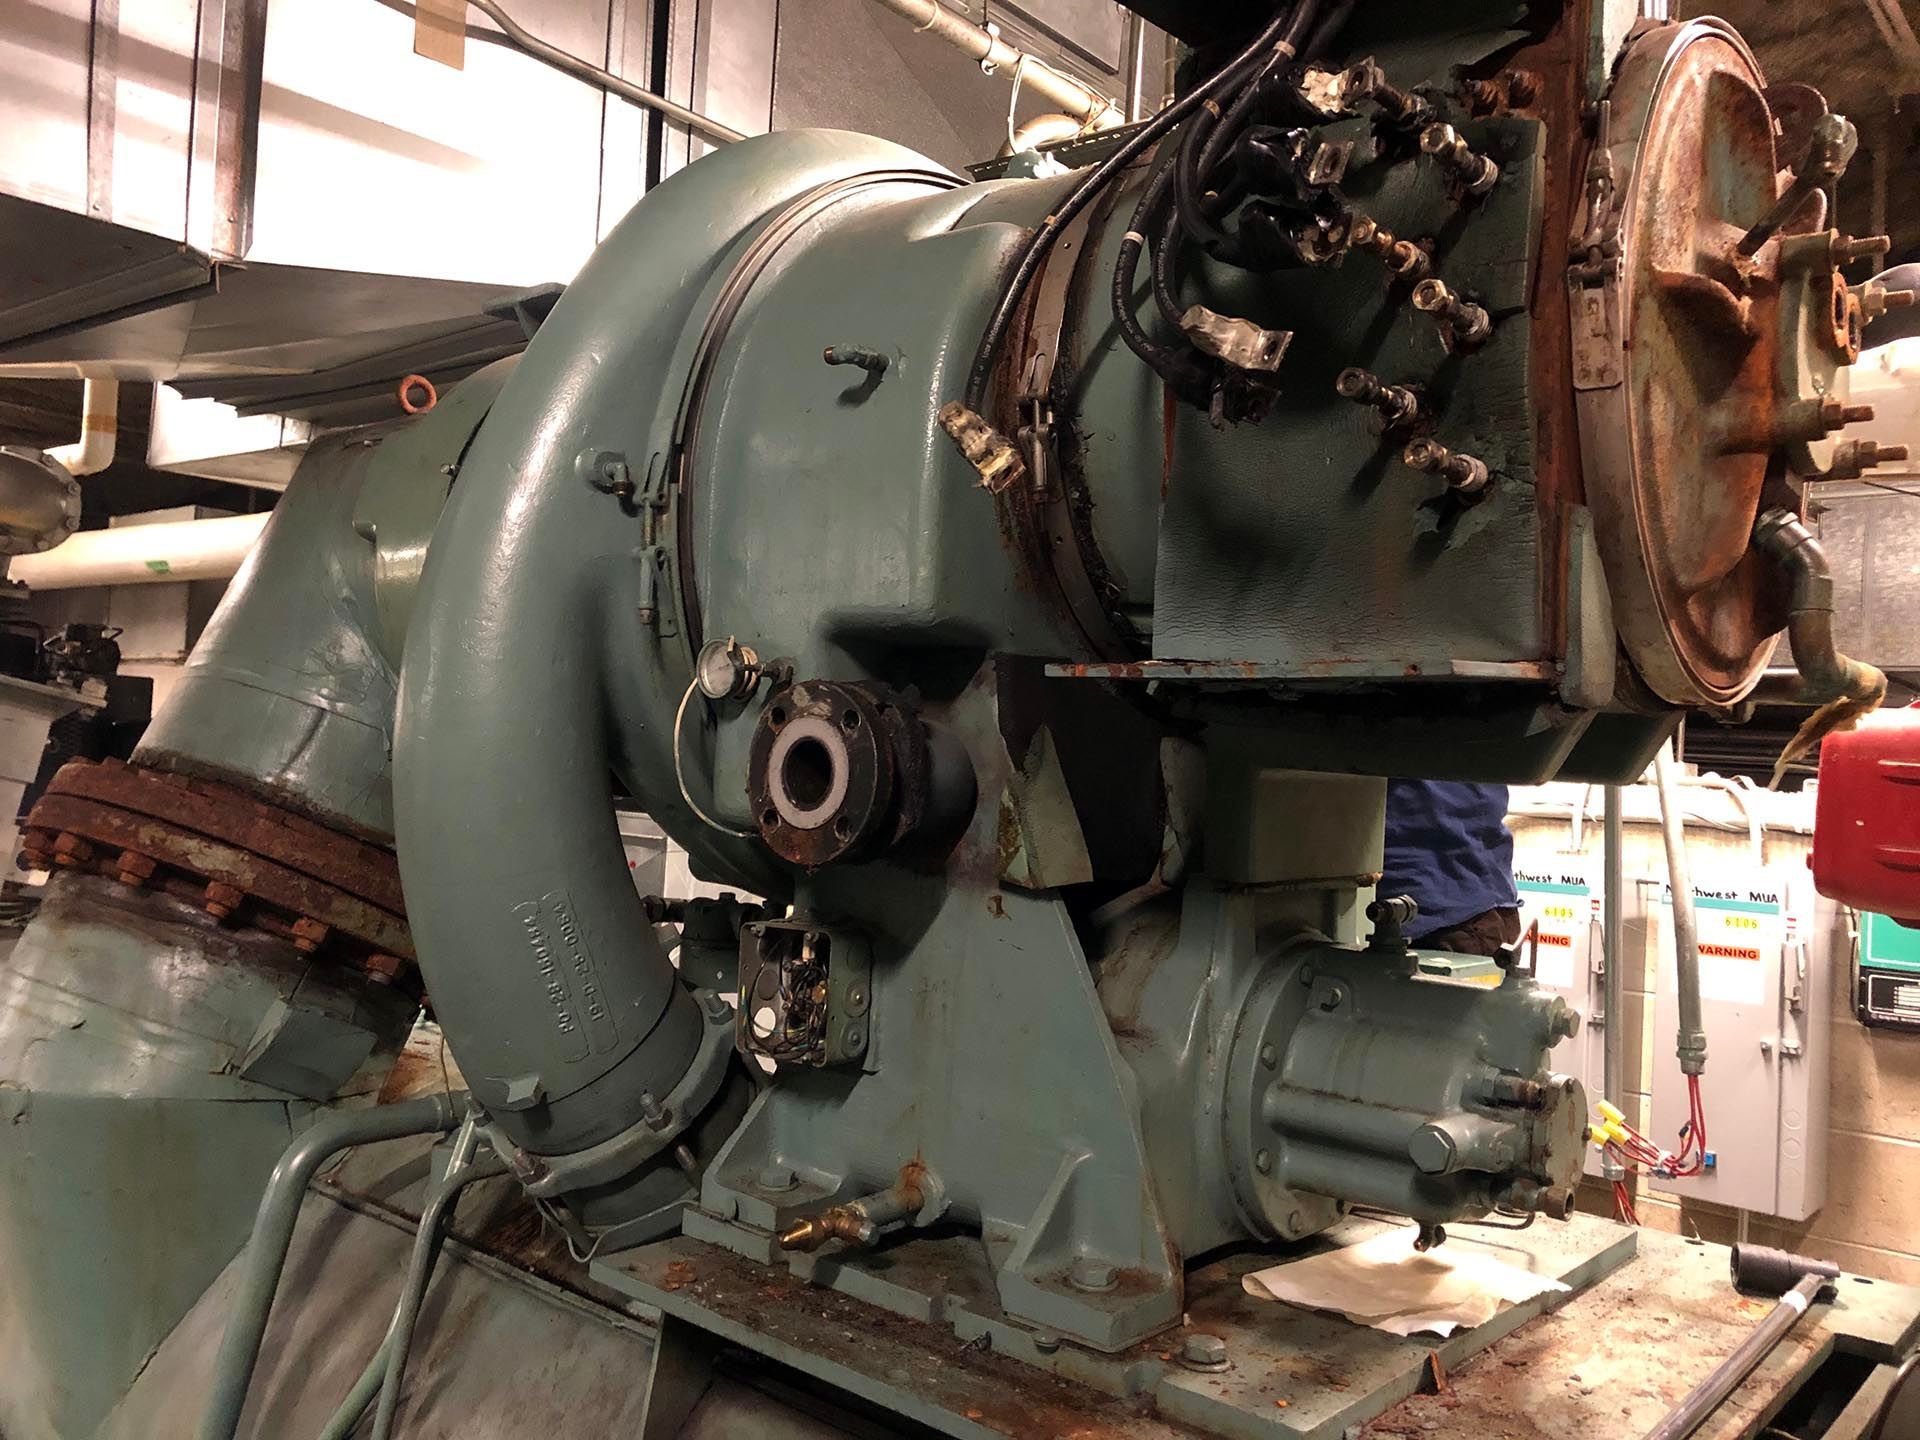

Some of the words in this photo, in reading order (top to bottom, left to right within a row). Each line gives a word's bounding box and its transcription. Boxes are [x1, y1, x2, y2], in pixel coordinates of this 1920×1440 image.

[1514, 870, 1552, 883] thwest
[1561, 875, 1585, 886] MUA
[1666, 884, 1738, 899] Nhwest
[1749, 891, 1779, 903] MUA
